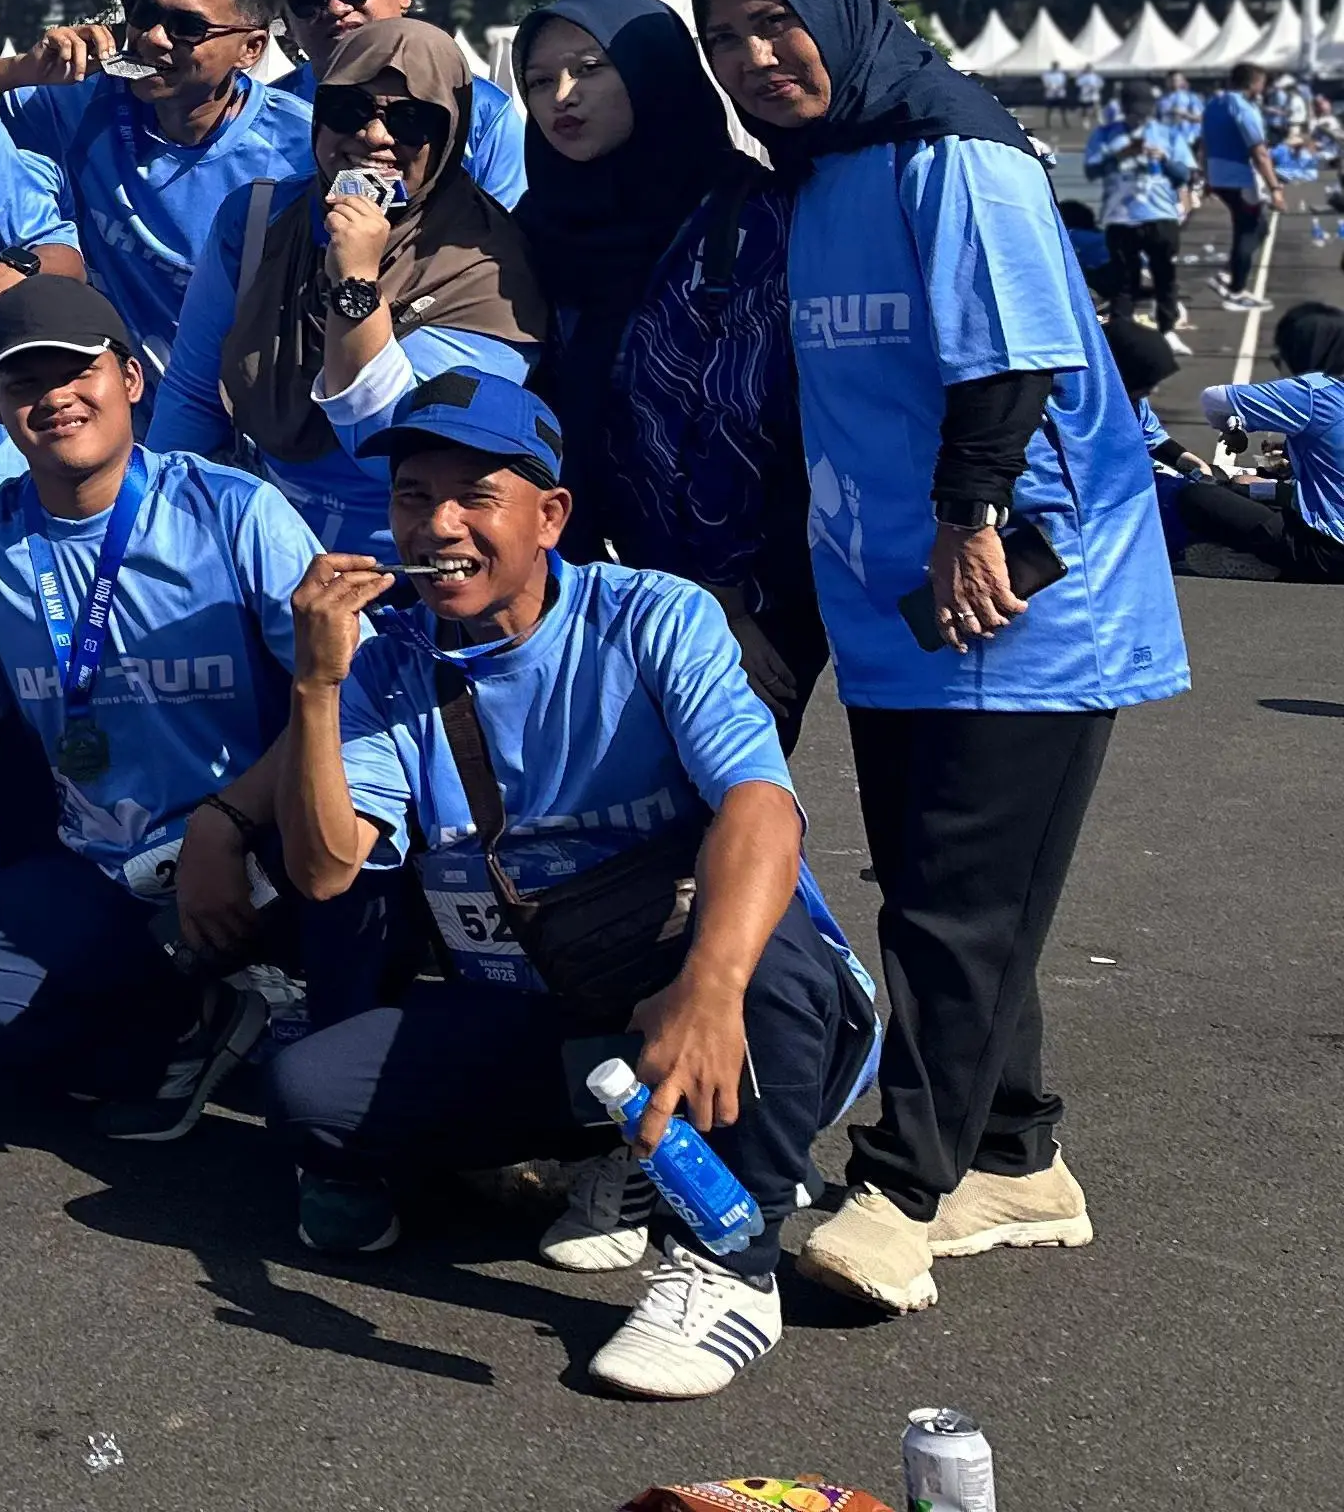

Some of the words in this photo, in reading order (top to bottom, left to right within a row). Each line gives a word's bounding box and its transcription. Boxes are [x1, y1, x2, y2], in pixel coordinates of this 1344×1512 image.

[791, 293, 911, 349] -RUN
[40, 571, 59, 597] RUN
[94, 577, 112, 604] RUN
[46, 598, 65, 620] AHY
[89, 602, 107, 628] AHY
[16, 654, 234, 703] AH-RUN
[456, 904, 513, 943] 52
[484, 968, 517, 983] 2025
[638, 1158, 704, 1228] ISOPLU
